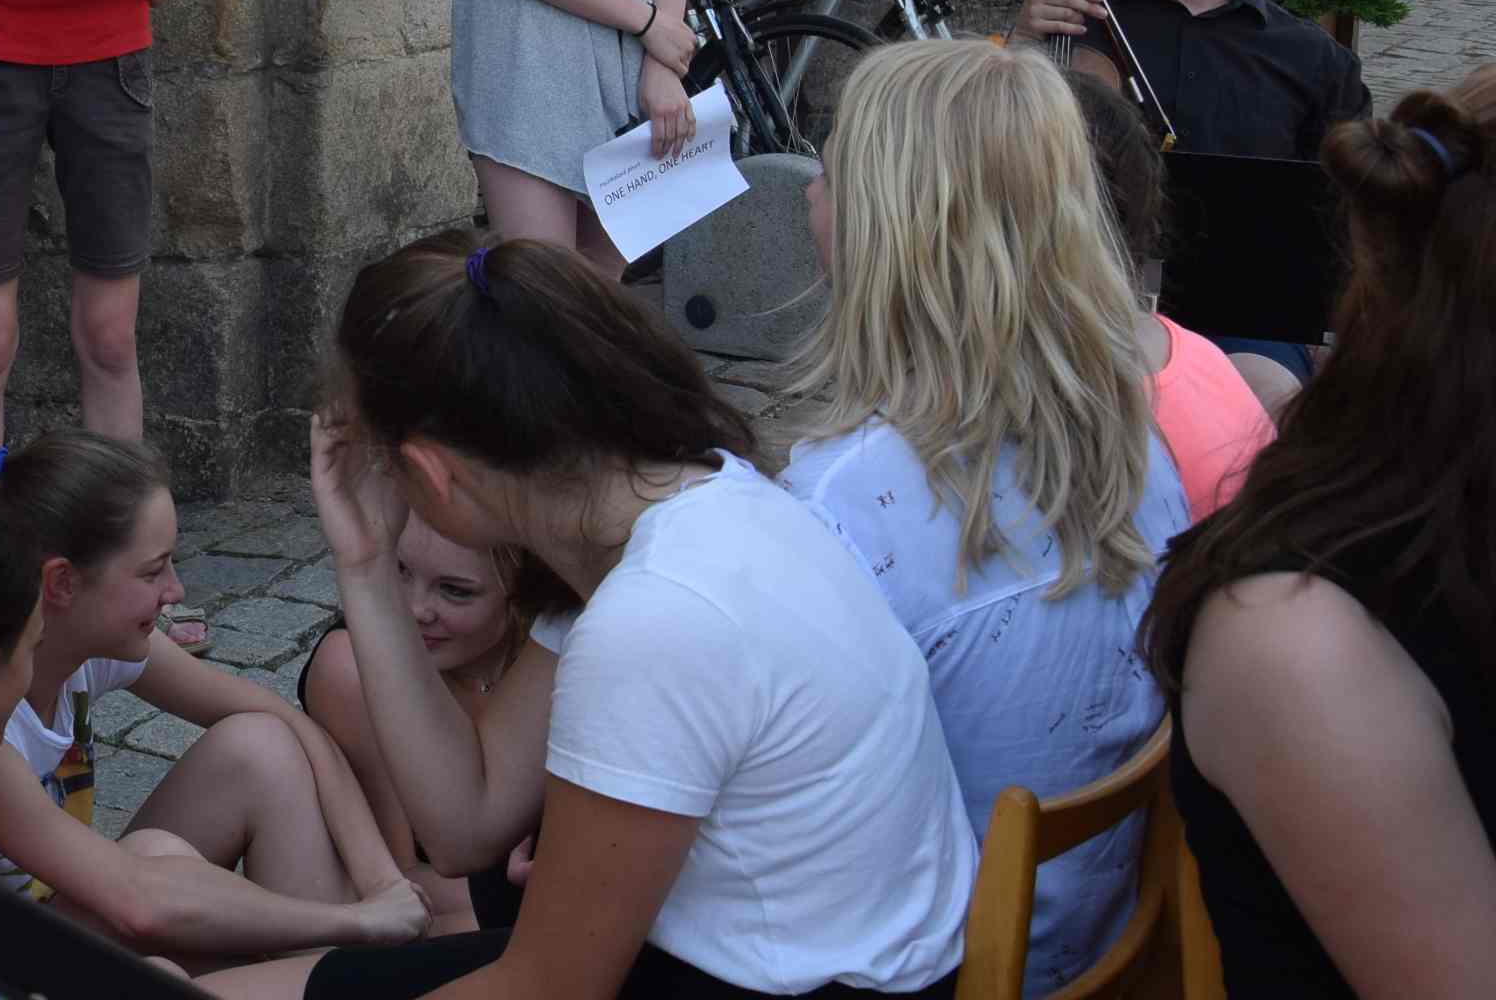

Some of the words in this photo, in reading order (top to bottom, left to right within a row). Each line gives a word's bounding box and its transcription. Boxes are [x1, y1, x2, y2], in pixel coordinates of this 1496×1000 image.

[604, 186, 627, 206] ONE
[627, 170, 658, 194] HAND,
[658, 157, 679, 175] ONE
[681, 139, 715, 162] HEART
